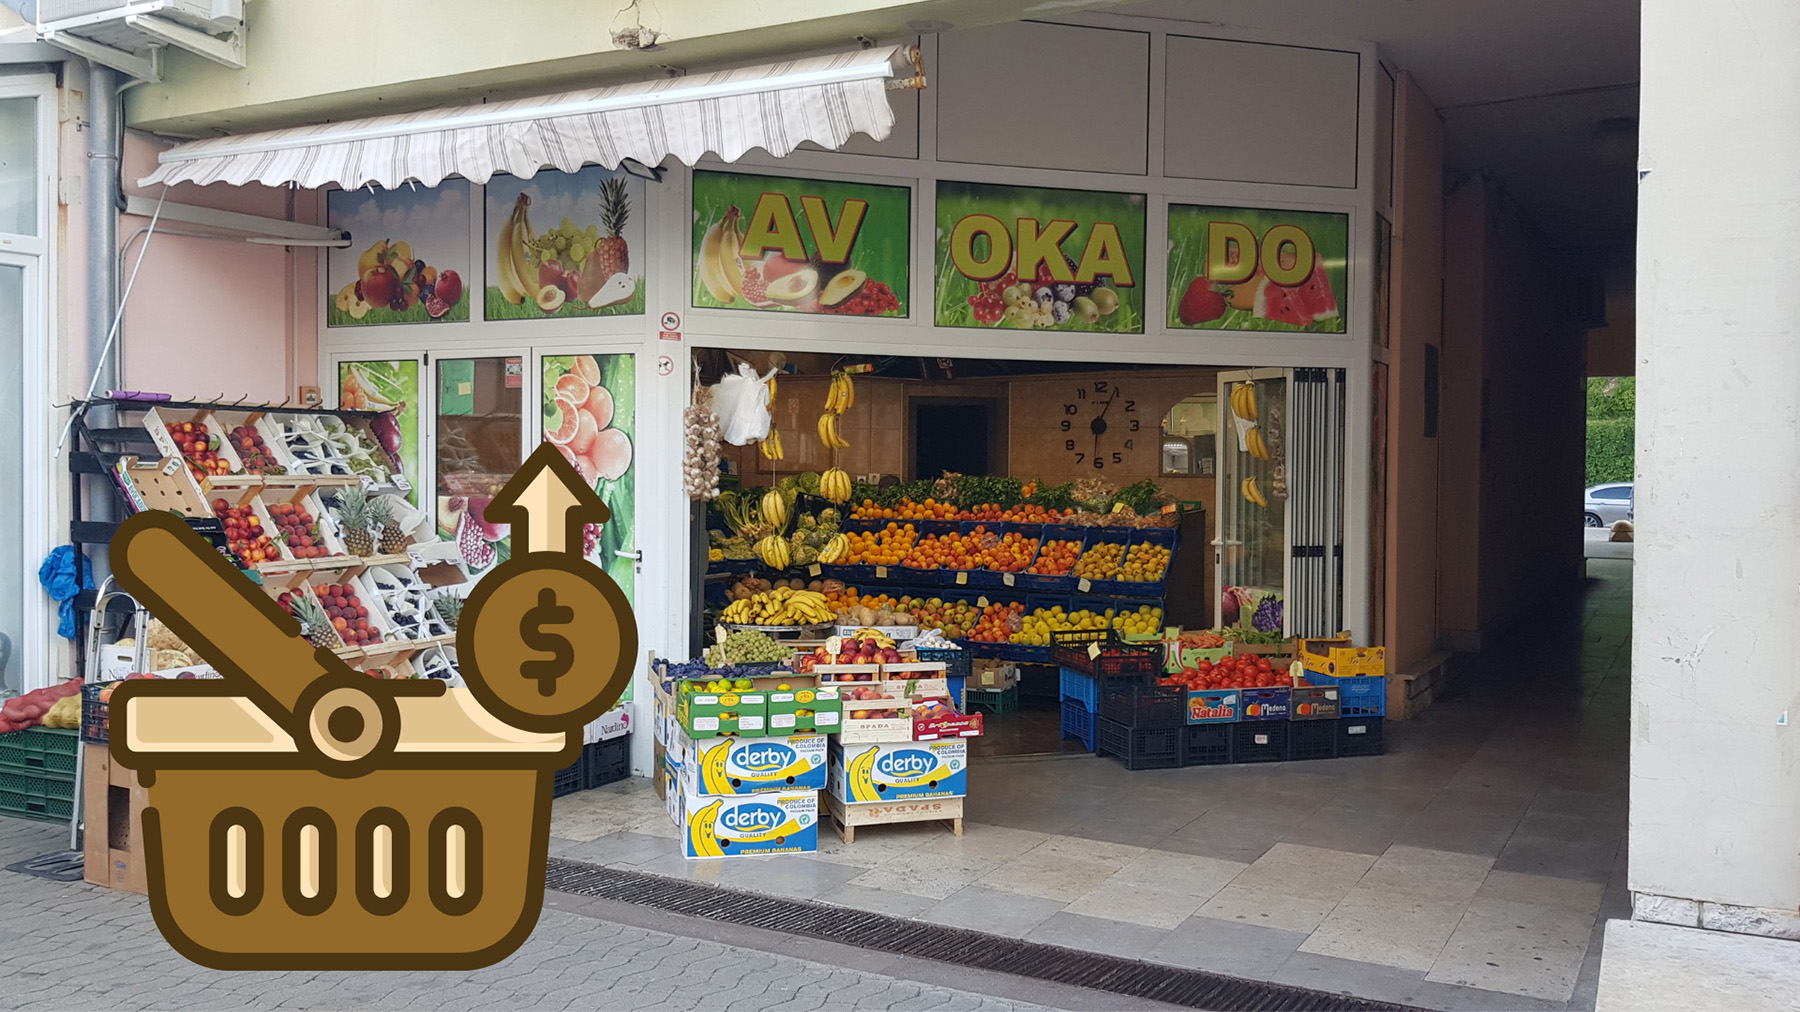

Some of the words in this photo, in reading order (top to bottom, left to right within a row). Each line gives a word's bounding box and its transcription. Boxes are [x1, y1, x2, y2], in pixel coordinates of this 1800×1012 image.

[739, 192, 869, 264] AV
[950, 214, 1135, 287] OKA
[1207, 221, 1315, 288] DO
[1093, 381, 1108, 393] 12
[1077, 388, 1086, 399] 11
[1063, 404, 1077, 415] 10
[1125, 401, 1135, 412] 2
[1061, 420, 1071, 432] 9
[1129, 420, 1139, 431] 3
[1066, 440, 1075, 450] 8
[1124, 439, 1133, 450] 4
[1075, 453, 1085, 464] 7
[1093, 457, 1104, 469] 6
[1112, 452, 1121, 463] 5
[1191, 704, 1234, 720] Natalia
[736, 745, 792, 768] derby
[881, 752, 933, 775] derby
[883, 803, 942, 813] SPADA
[725, 805, 781, 829] derby
